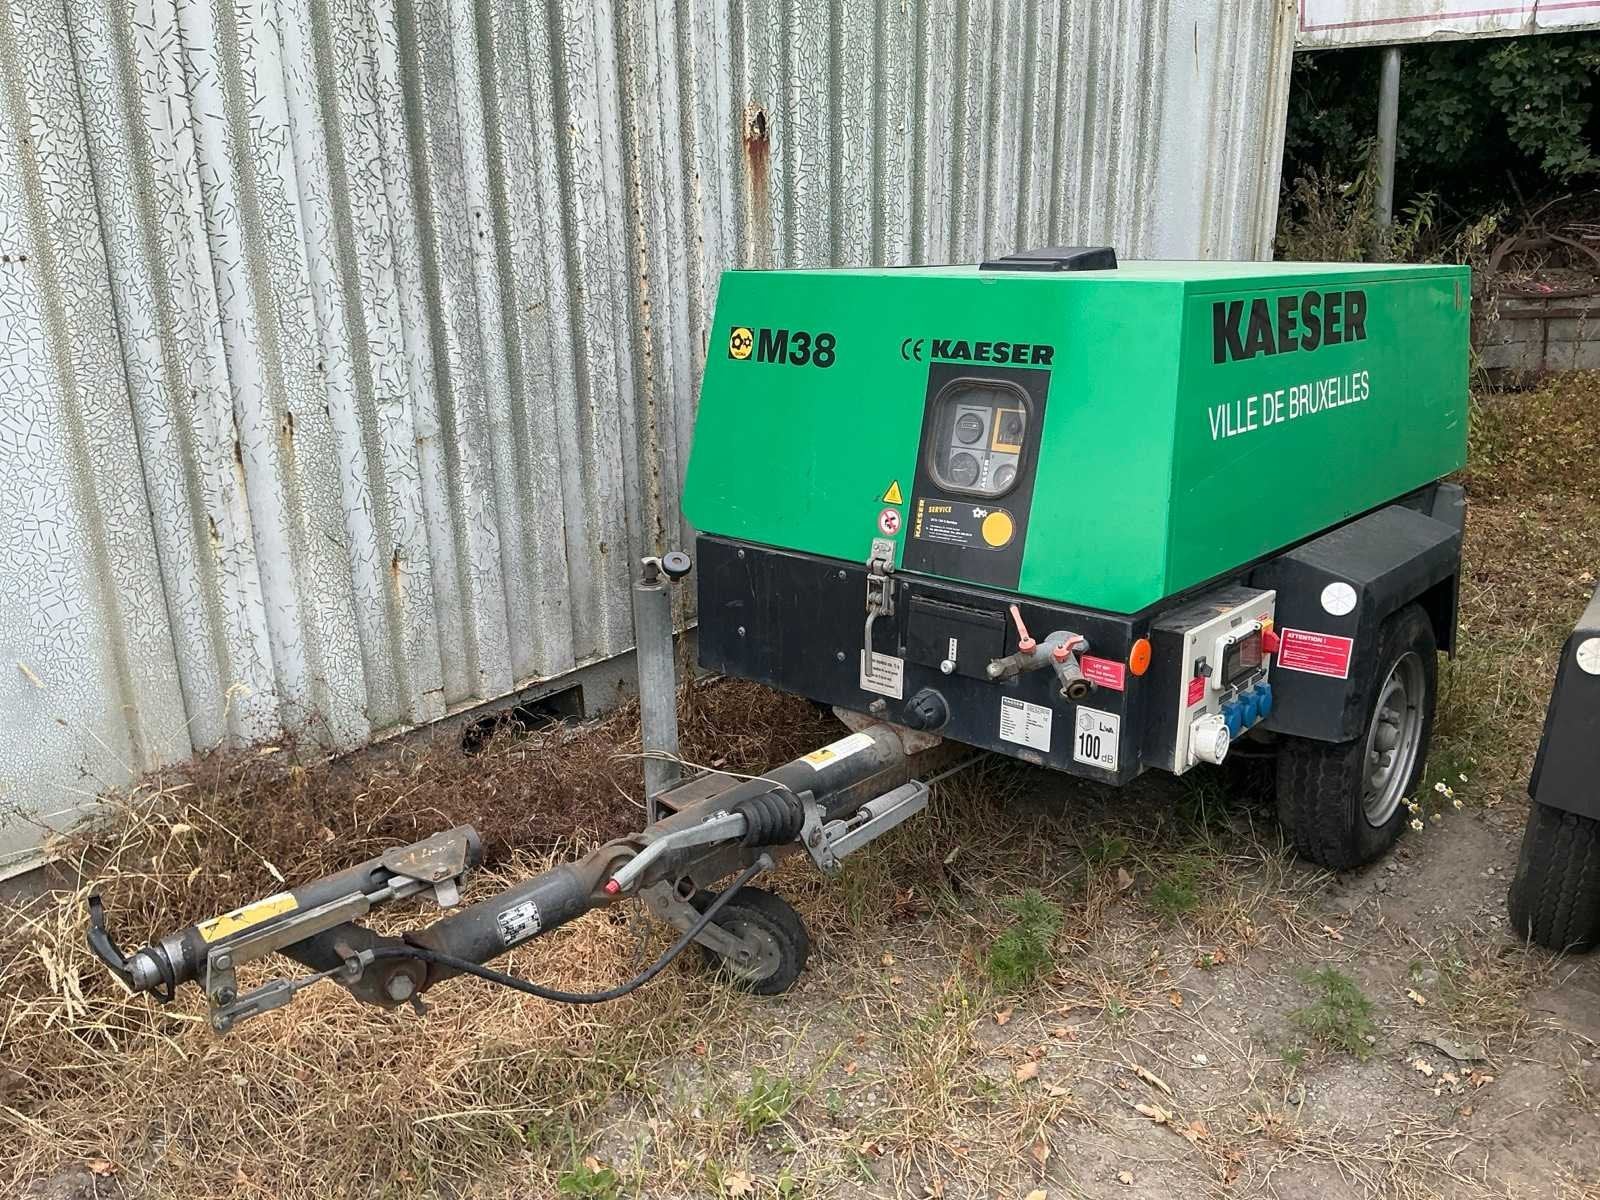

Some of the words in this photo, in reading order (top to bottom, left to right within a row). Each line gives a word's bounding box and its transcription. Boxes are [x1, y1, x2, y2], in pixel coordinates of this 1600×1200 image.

[1212, 290, 1367, 365] KAESER
[756, 328, 836, 368] M38
[931, 339, 1055, 366] KAESER
[1208, 396, 1258, 441] VILLE
[1263, 389, 1285, 427] DE
[1289, 371, 1369, 419] BRUXELLES
[914, 499, 925, 538] KAESER
[1287, 632, 1323, 643] ATTENTION
[1079, 732, 1100, 760] 100
[1101, 754, 1114, 764] dB
